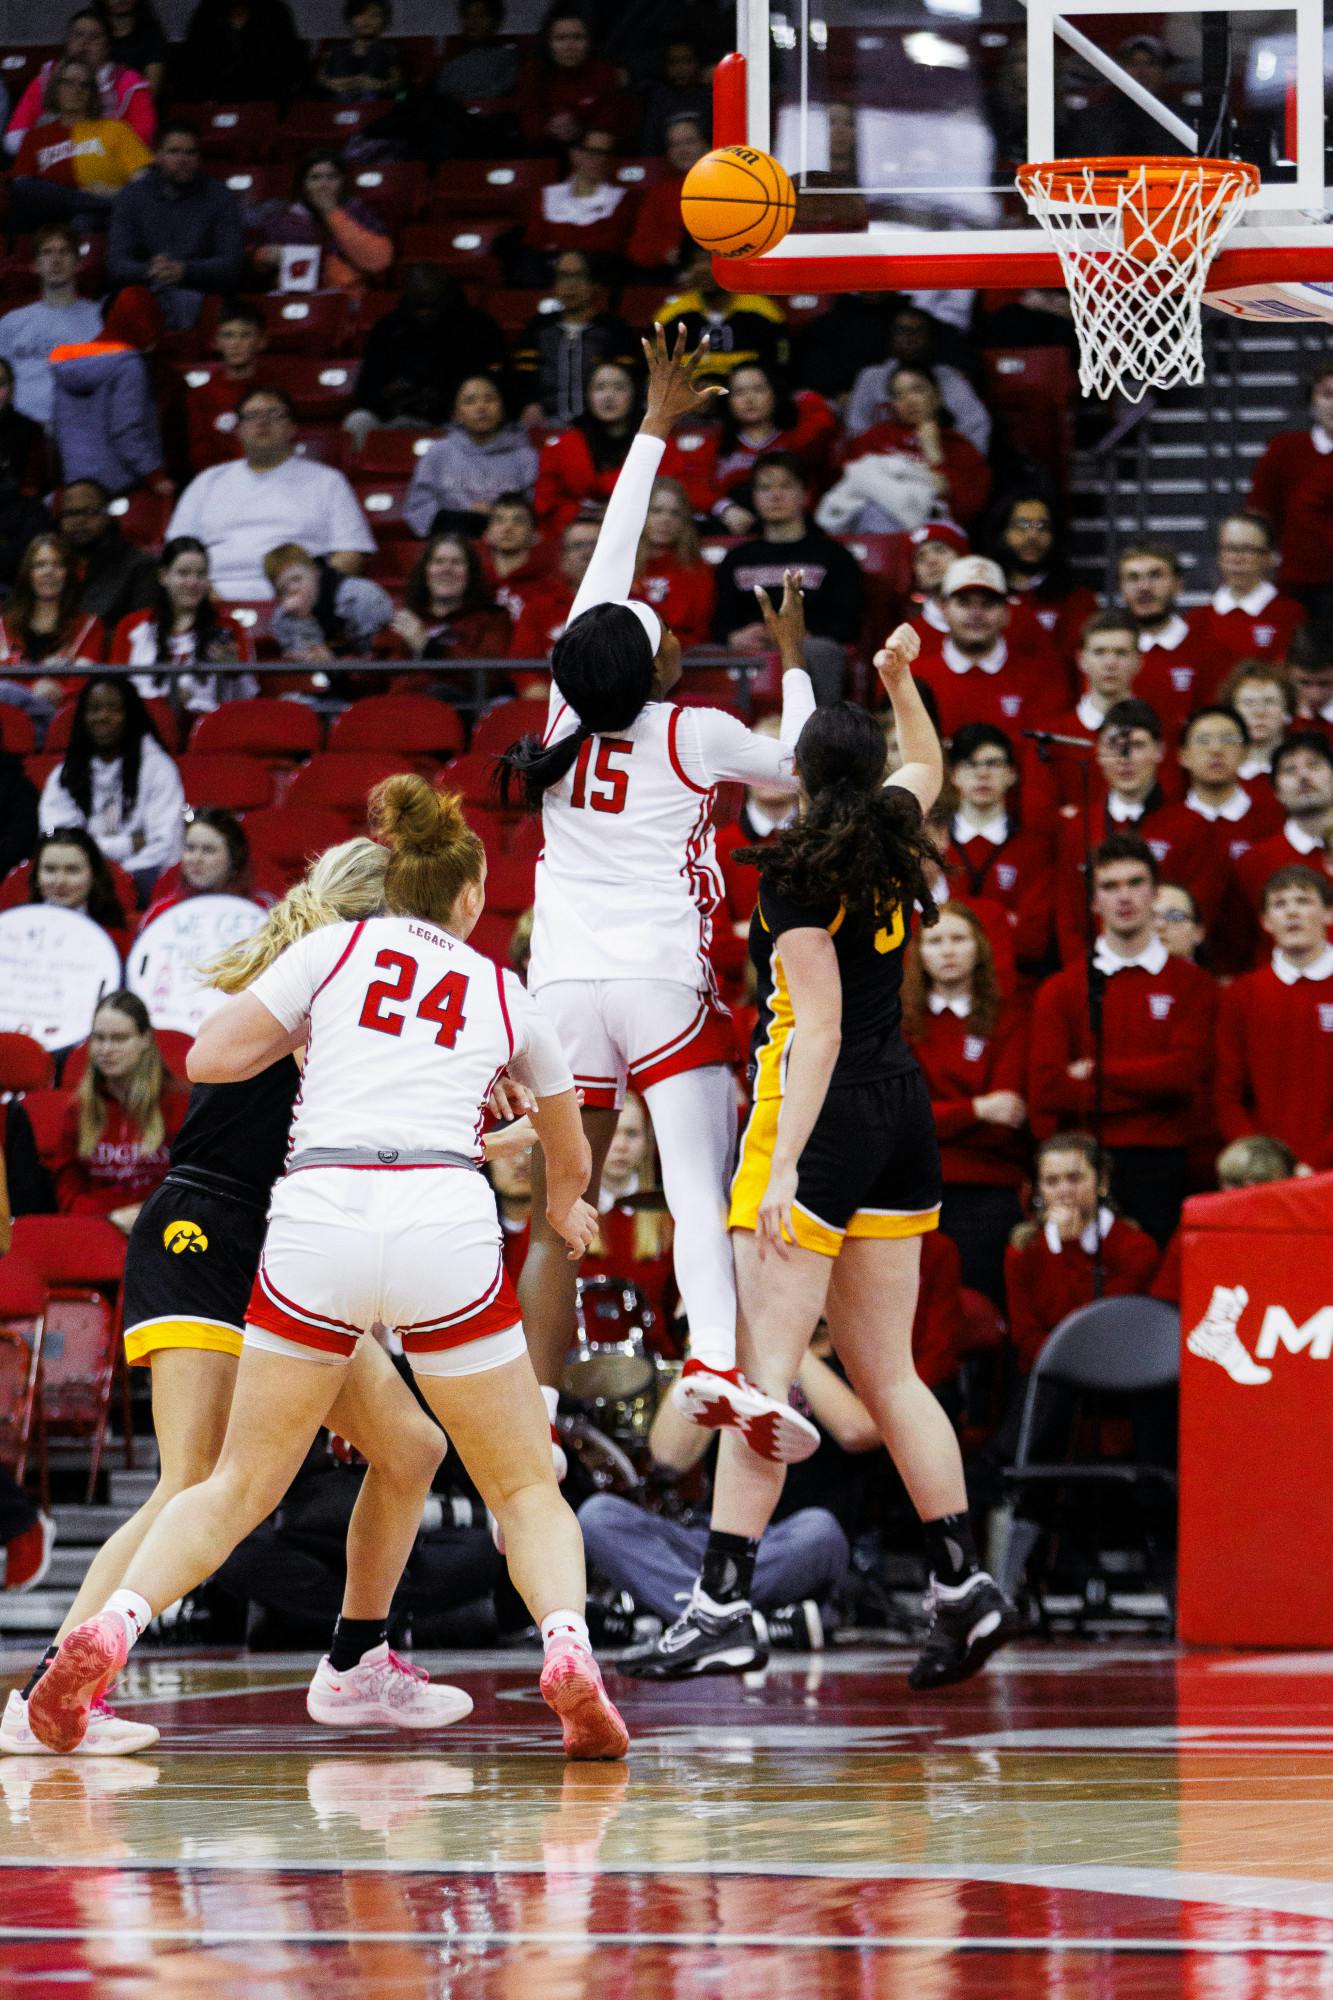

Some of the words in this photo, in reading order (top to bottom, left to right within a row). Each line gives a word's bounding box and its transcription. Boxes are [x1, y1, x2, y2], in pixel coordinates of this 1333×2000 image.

[570, 735, 634, 814] 15
[408, 924, 455, 952] LEGACY
[358, 948, 470, 1051] 24
[1256, 1305, 1333, 1360] M
